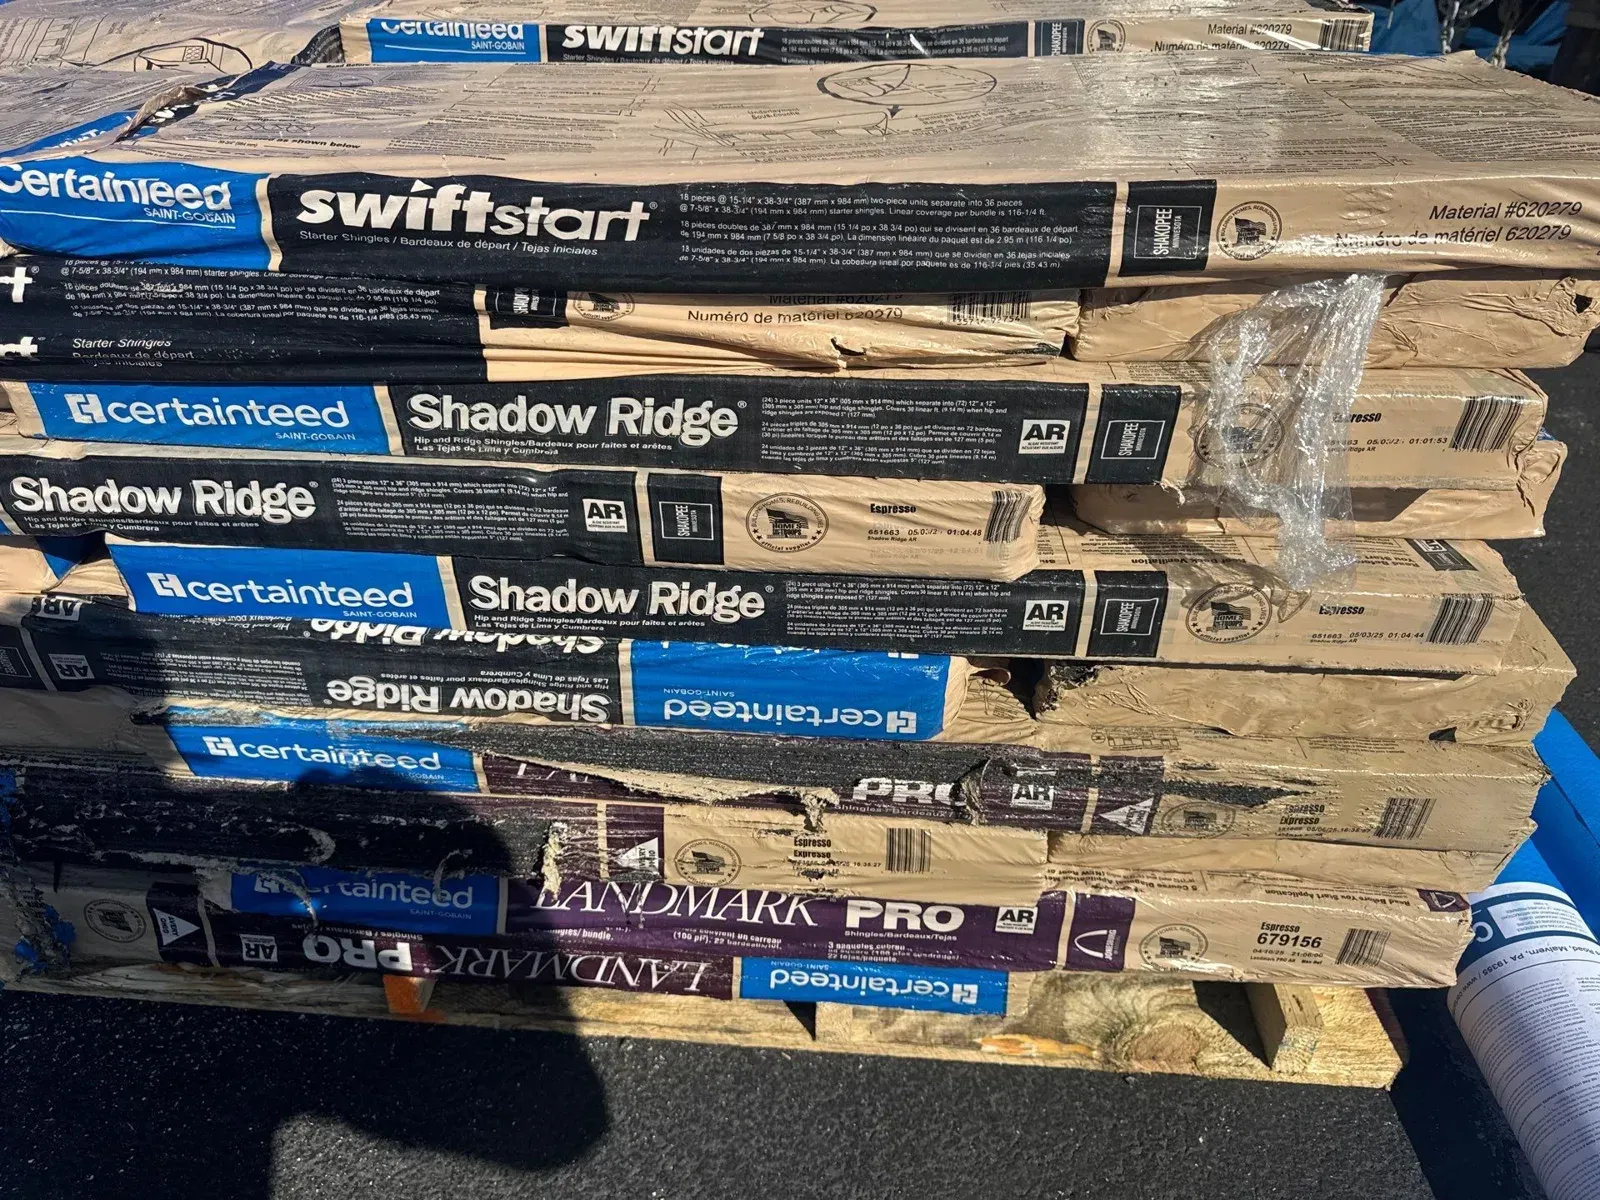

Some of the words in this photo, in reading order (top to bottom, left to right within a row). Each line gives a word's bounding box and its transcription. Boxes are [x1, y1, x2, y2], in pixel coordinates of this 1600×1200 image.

[1207, 24, 1247, 35] Material
[471, 40, 525, 51] SAINT-GOBAIN
[563, 53, 585, 62] Starter
[330, 141, 361, 149] below
[691, 195, 716, 204] pieces
[718, 195, 727, 204] @
[764, 197, 792, 205] 38-3/4"
[794, 197, 812, 206] (387
[870, 197, 908, 206] two-piece
[909, 198, 929, 206] units
[931, 199, 965, 208] separate
[968, 199, 983, 207] into
[984, 199, 994, 207] 36
[996, 199, 1023, 209] pieces
[1428, 203, 1502, 220] Material
[1503, 201, 1582, 219] #620279
[143, 207, 236, 224] SAINT-GOBAIN
[679, 204, 689, 213] @
[690, 204, 713, 213] 7-5/8"
[721, 205, 749, 214] 38-3/4"
[750, 207, 768, 216] (194
[793, 207, 808, 215] 984
[810, 207, 828, 216] mm)
[855, 207, 886, 217] shingles.
[889, 208, 914, 216] Linear
[916, 209, 952, 218] coverage
[954, 210, 968, 218] per
[970, 209, 997, 217] bundle
[998, 209, 1005, 217] is
[1008, 208, 1037, 217] 116-1/4
[1153, 208, 1172, 256] SHAKOPEE
[1172, 215, 1183, 249] MINNESOTA
[1406, 230, 1429, 245] de
[1434, 226, 1501, 244] matériel
[1505, 225, 1571, 242] 620279
[300, 230, 339, 242] Starter
[341, 233, 391, 245] Shingles
[400, 237, 454, 248] Bardeaux
[457, 239, 472, 248] de
[474, 238, 511, 252] départ
[521, 242, 550, 255] Tejas
[553, 243, 598, 256] iniciales
[687, 309, 749, 323] Numéro
[753, 312, 771, 325] de
[777, 310, 841, 323] matériel
[844, 307, 903, 320] 620279
[72, 338, 112, 349] Starter
[117, 338, 172, 350] Shingles
[134, 351, 150, 359] de
[154, 350, 194, 360] départ
[107, 397, 350, 428] certainteed
[407, 393, 597, 435] Shadow
[275, 431, 356, 442] SAINT-GOBAIN
[1023, 423, 1066, 441] AR
[1118, 422, 1139, 456] SHAKOPEE
[413, 436, 431, 447] Hip
[432, 437, 451, 445] and
[453, 437, 482, 448] Ridge
[484, 438, 573, 449] Shingles/Bardeaux
[576, 442, 598, 450] pour
[630, 442, 639, 450] et
[1408, 437, 1448, 445] 01:01:53
[11, 476, 183, 515] Shadow
[587, 502, 624, 520] AR
[870, 503, 917, 515] Espresso
[675, 504, 690, 537] SHAKOPEE
[946, 529, 982, 537] 01:04:48
[187, 579, 414, 608] certainteed
[468, 575, 639, 616] Shadow
[342, 610, 418, 619] SAINT-GOBAIN
[1027, 603, 1065, 620] AR
[1116, 601, 1135, 632] SHAKOPEE
[1319, 604, 1365, 616] Espresso
[60, 666, 90, 678] AR
[663, 688, 735, 698] SAINT-GOBAIN
[450, 687, 612, 722] Shadow
[664, 699, 883, 728] certainteed
[240, 742, 441, 770] certainteed
[1279, 816, 1320, 826] Expresso
[793, 836, 832, 848] Espresso
[793, 850, 831, 859] Expresso
[409, 908, 472, 920] SAINT-GOBAIN
[529, 881, 820, 927] LANDMARK
[845, 899, 965, 933] PRO
[999, 907, 1034, 924] AR
[160, 917, 170, 934] OHIO
[167, 915, 179, 937] AVERY
[1260, 921, 1301, 933] Espresso
[844, 930, 958, 942] Shingles/Bardeaux/Tejas
[1257, 932, 1323, 949] 679156
[245, 943, 275, 959] AR
[303, 934, 413, 972] PRO
[1510, 953, 1525, 963] PA
[1525, 946, 1569, 956] Malvern,
[432, 946, 713, 993] LANDMARK
[1482, 959, 1509, 976] 19355
[769, 969, 950, 997] certainteed
